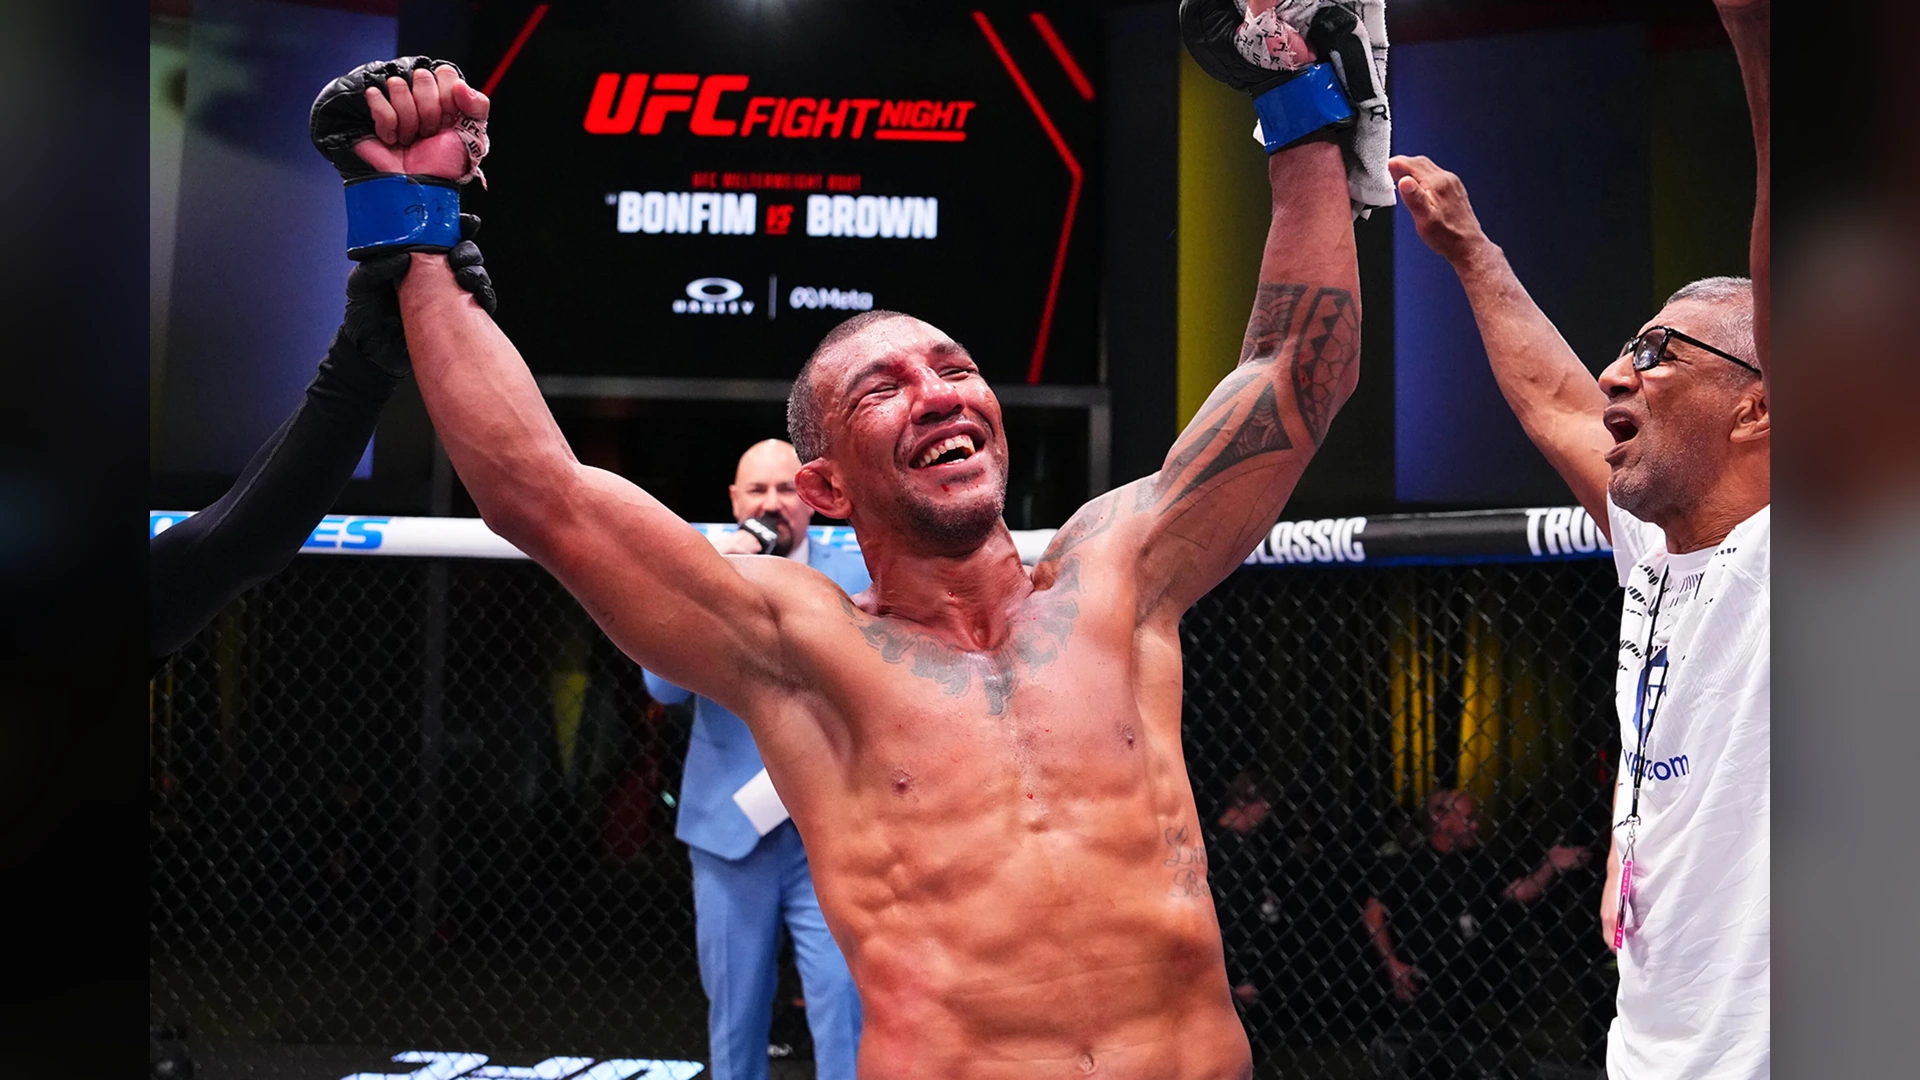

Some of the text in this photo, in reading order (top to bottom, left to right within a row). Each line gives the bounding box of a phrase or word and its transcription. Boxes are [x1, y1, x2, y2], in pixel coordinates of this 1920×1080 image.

[584, 72, 976, 139] UFC FIGHT NIGHT
[617, 191, 757, 234] BONFIM
[806, 194, 938, 239] BROWN
